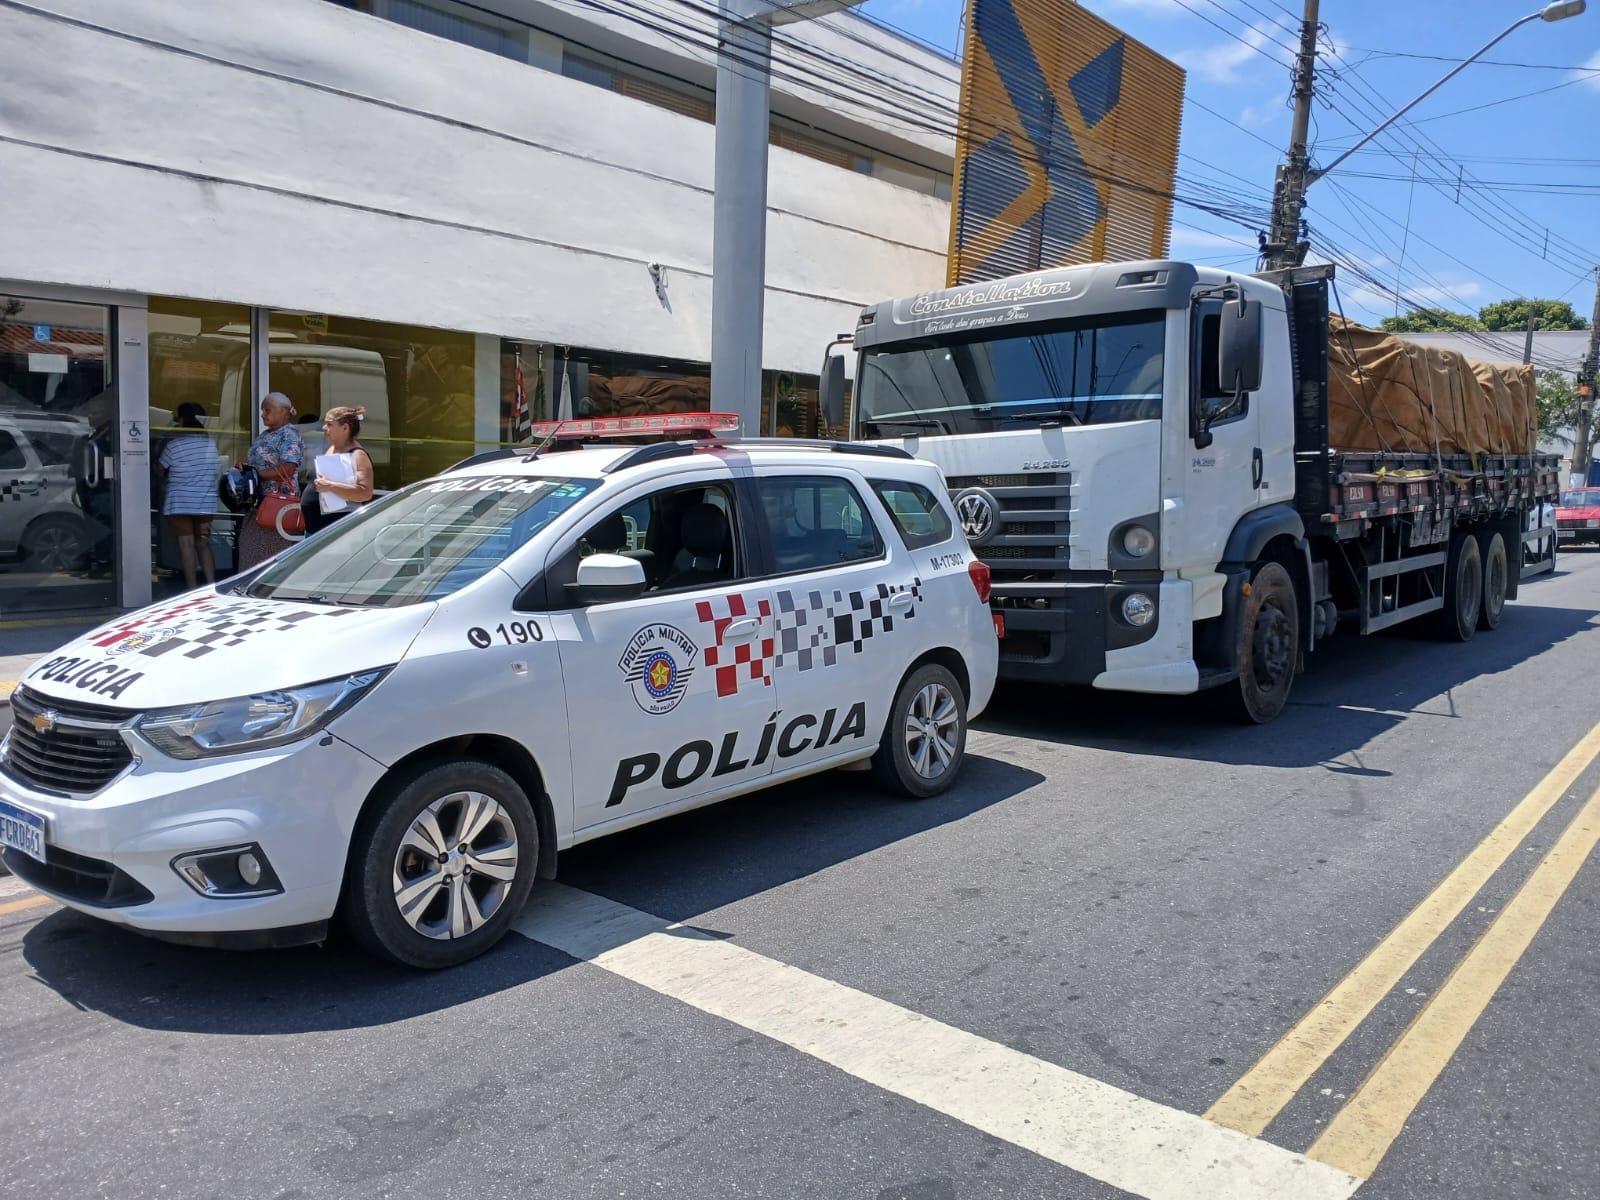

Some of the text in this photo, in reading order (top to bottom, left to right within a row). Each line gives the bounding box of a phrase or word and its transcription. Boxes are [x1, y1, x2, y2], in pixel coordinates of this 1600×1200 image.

[910, 278, 1071, 315] Constellation
[496, 620, 543, 645] 190
[659, 626, 693, 657] MILITAR
[28, 657, 145, 700] POLÍCIA
[605, 701, 866, 808] POLÍCIA
